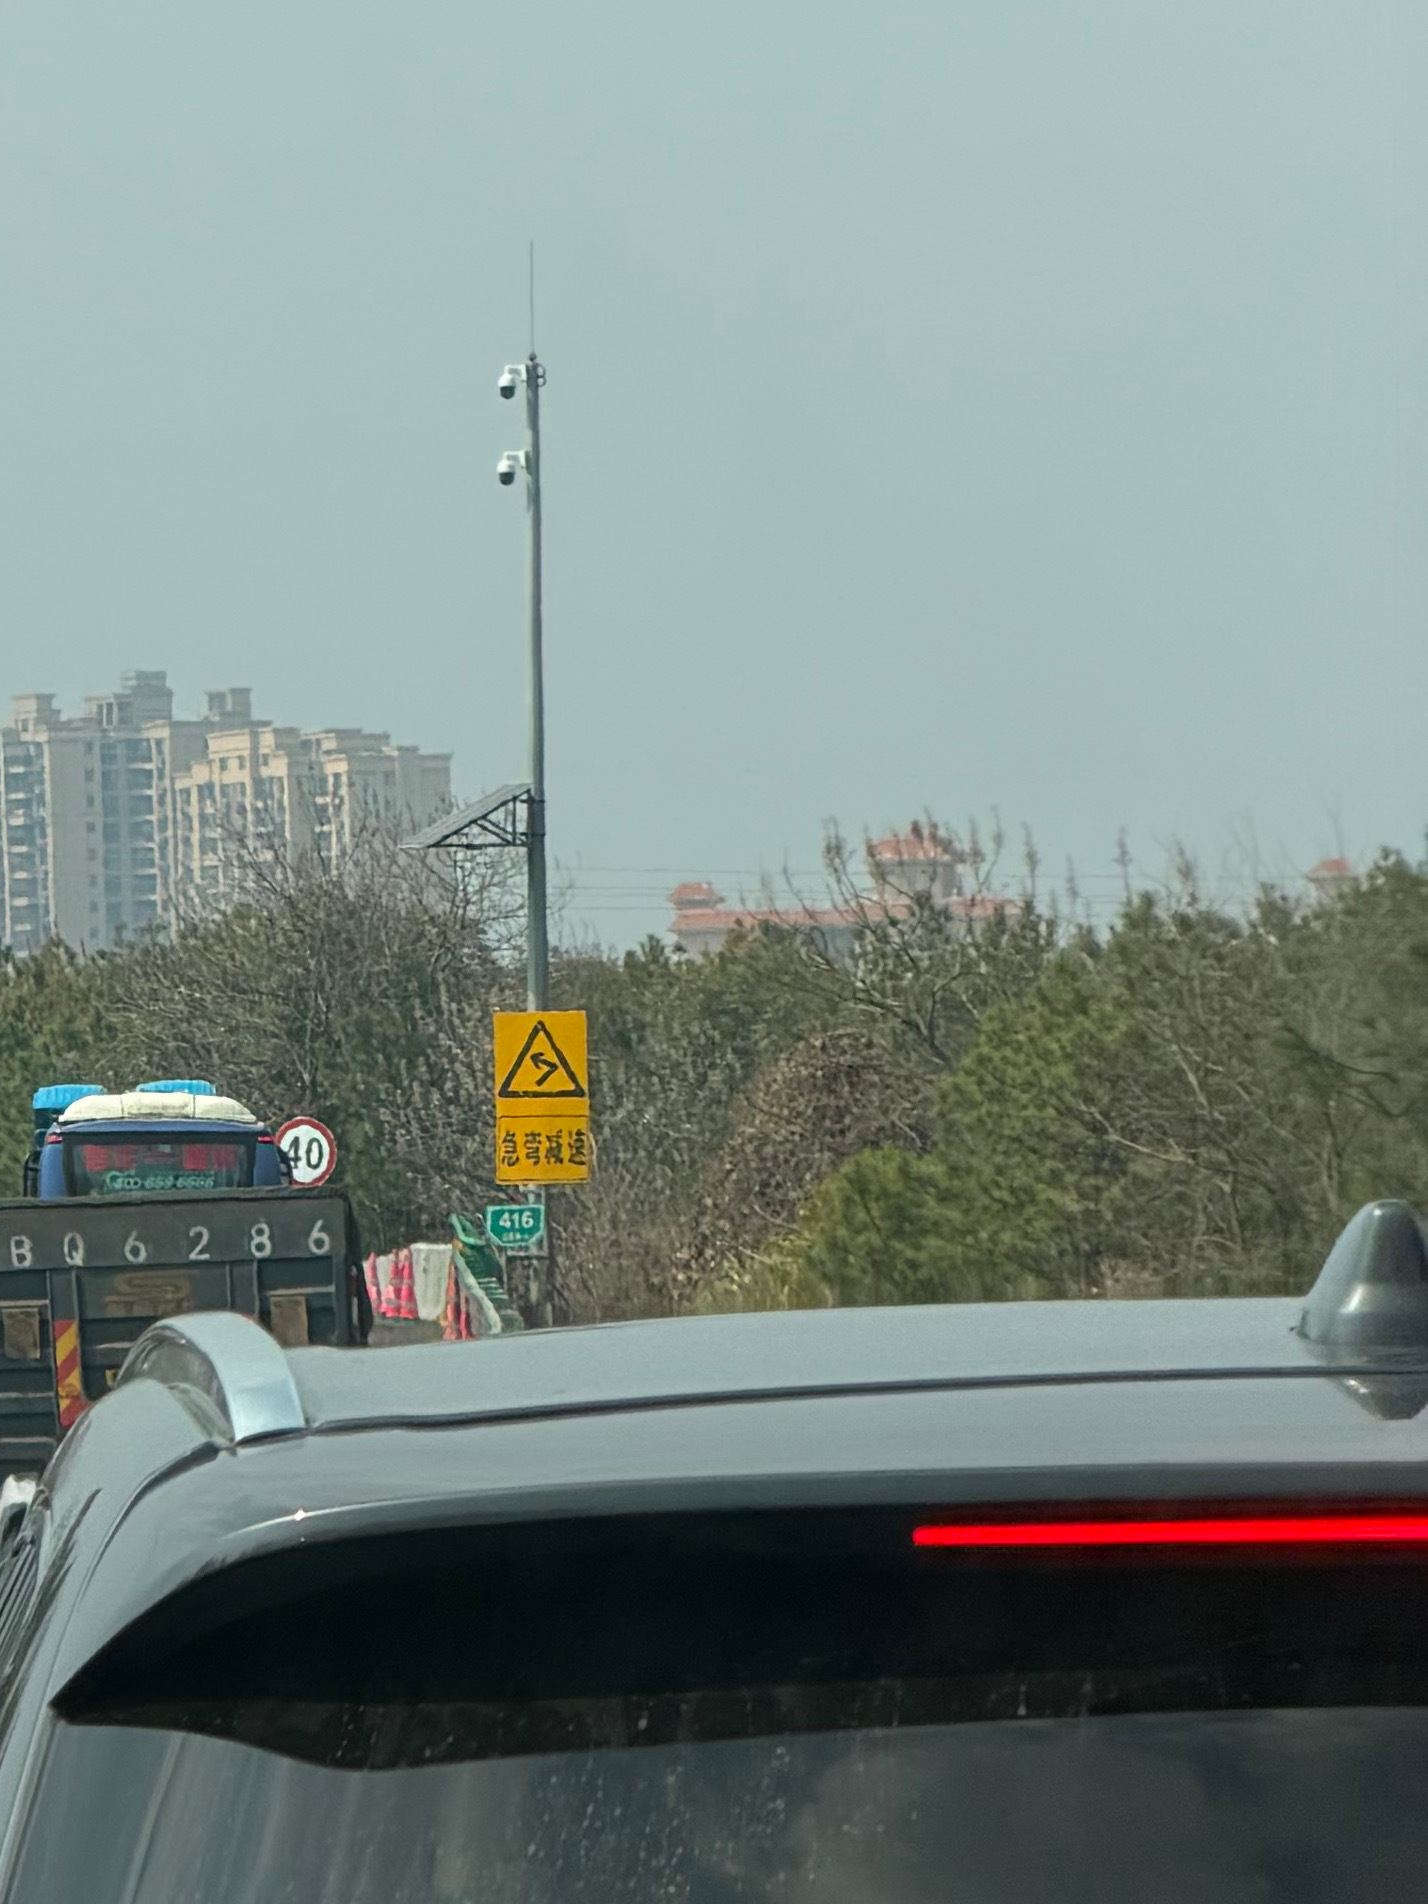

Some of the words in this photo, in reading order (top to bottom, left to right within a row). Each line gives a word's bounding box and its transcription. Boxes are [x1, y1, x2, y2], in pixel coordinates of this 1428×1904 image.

[288, 1135, 323, 1170] 40
[501, 1128, 587, 1167] 急弯减速
[499, 1211, 534, 1228] 416
